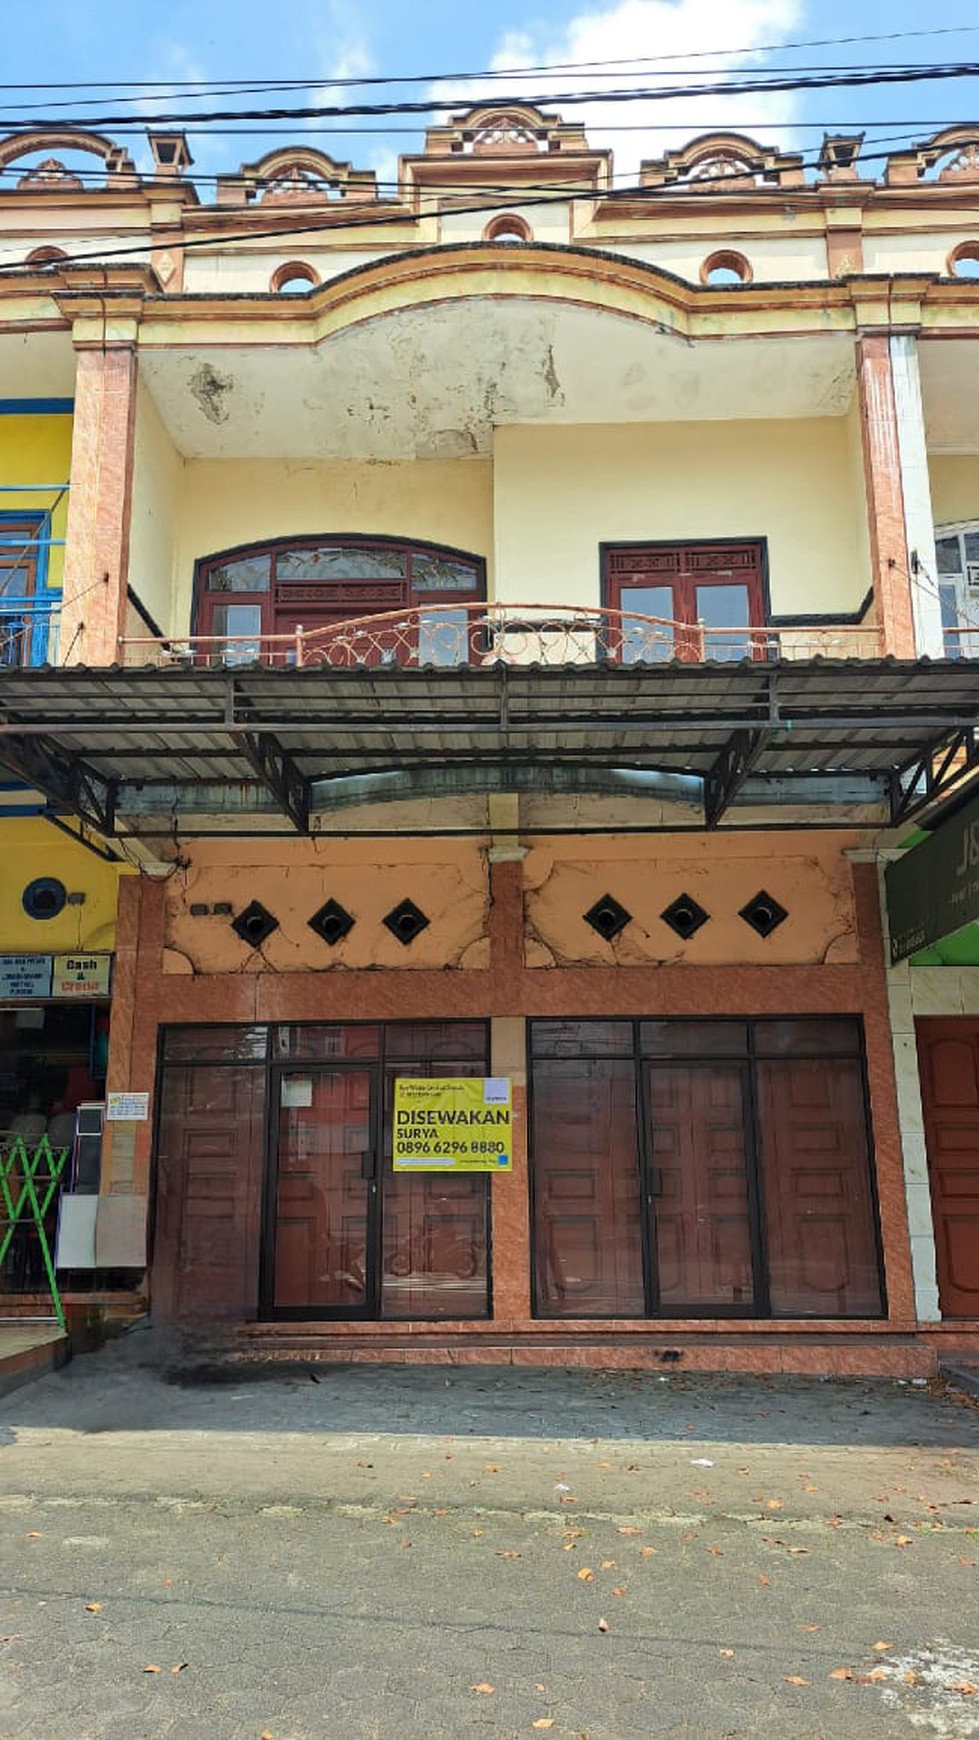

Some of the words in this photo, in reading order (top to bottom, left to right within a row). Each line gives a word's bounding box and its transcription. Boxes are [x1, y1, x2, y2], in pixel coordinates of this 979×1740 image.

[67, 960, 97, 970] Cash
[397, 1110, 510, 1125] DISEWAKAN
[397, 1128, 439, 1139] SURYA
[397, 1141, 430, 1154] 0896
[433, 1141, 468, 1154] 6296
[471, 1141, 505, 1154] 8880
